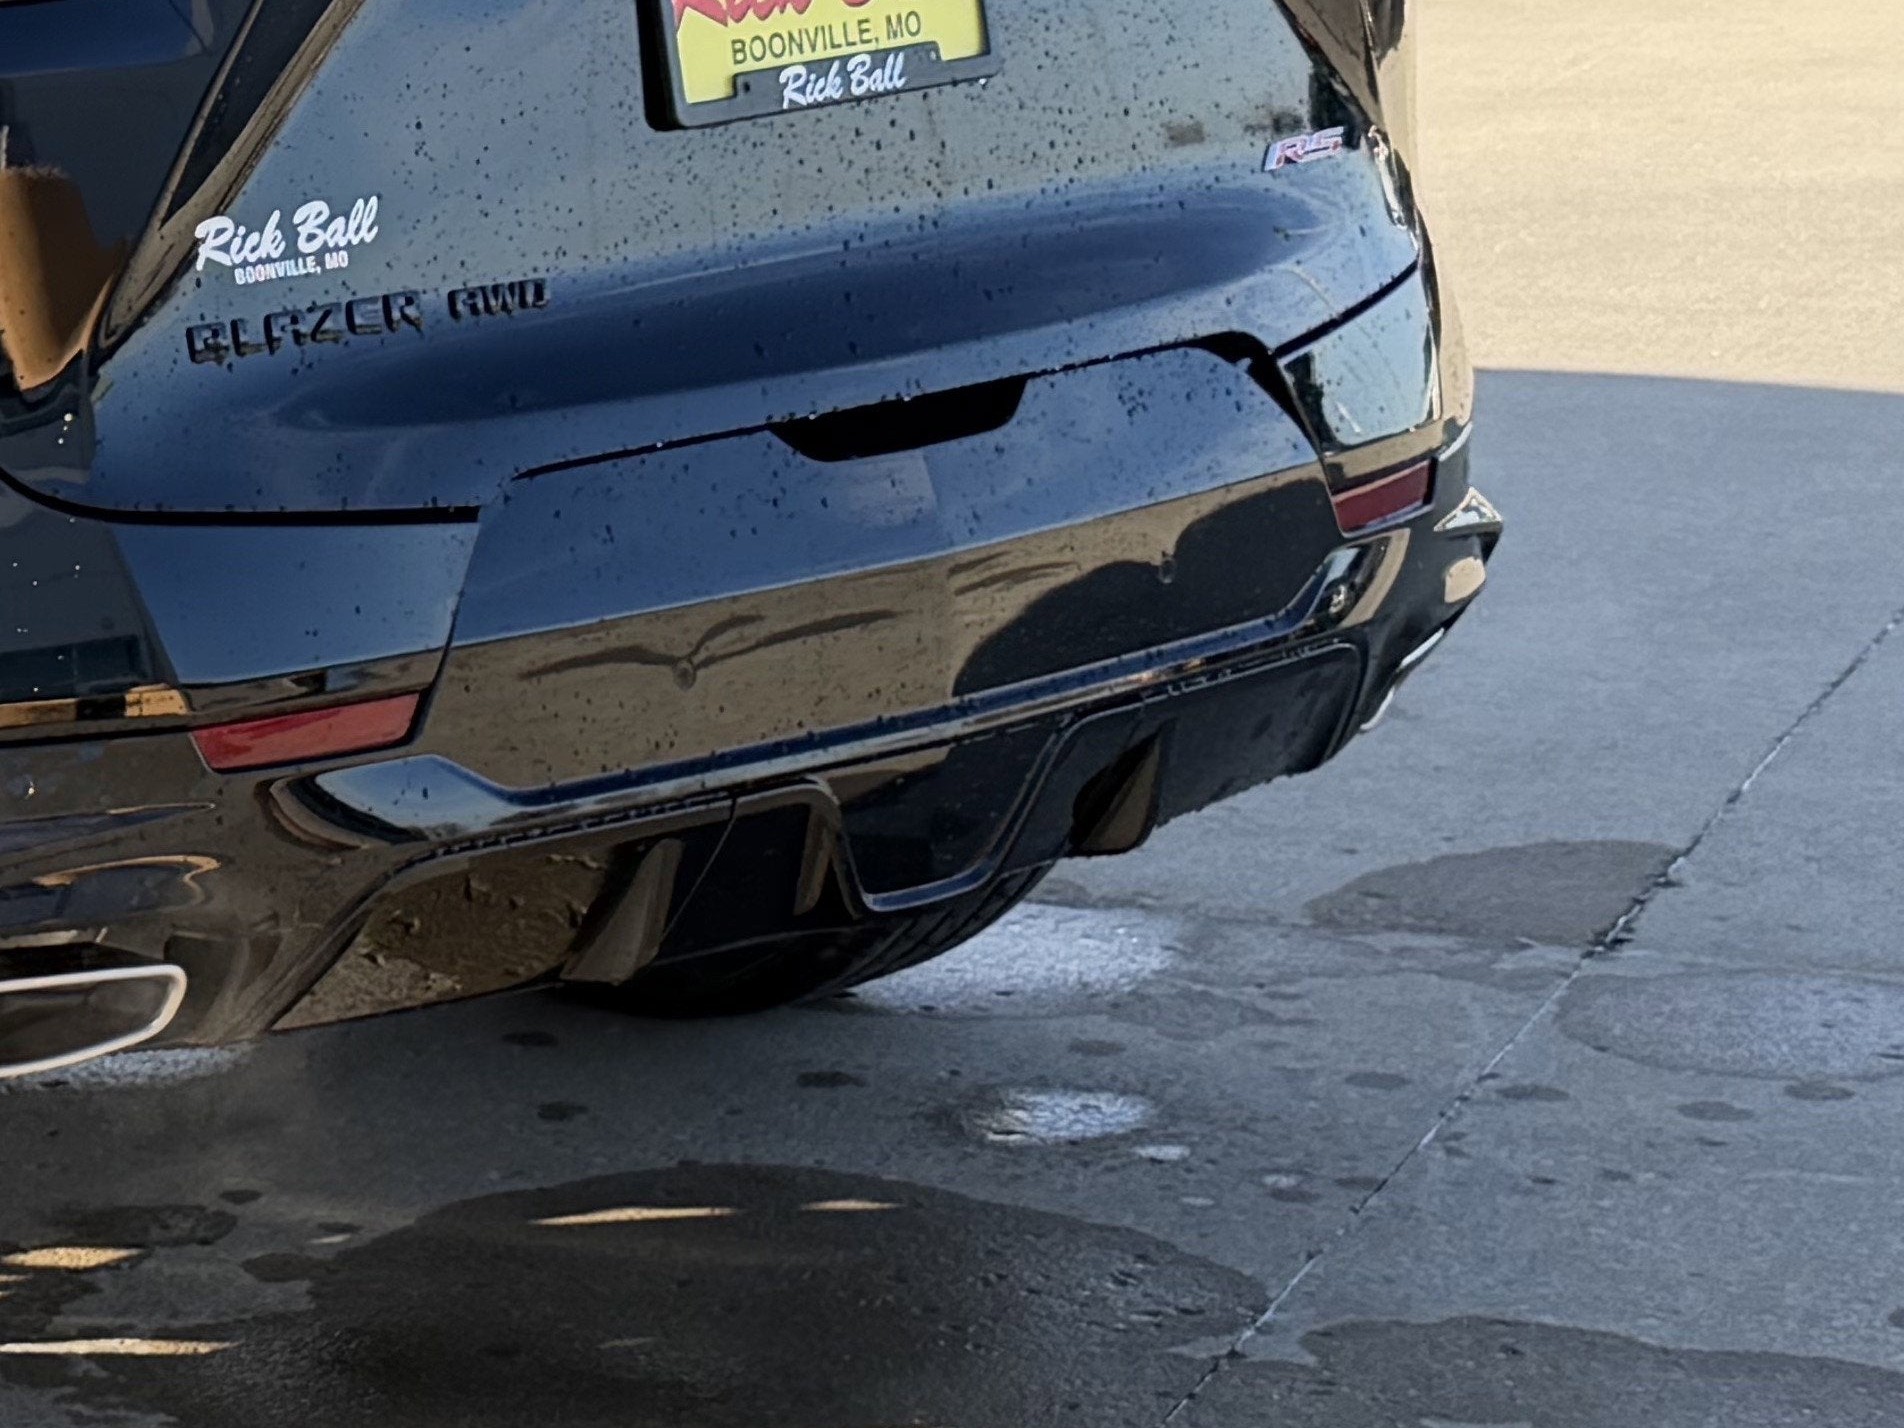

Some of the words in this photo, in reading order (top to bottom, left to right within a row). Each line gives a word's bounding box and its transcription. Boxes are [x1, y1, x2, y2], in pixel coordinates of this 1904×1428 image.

[731, 17, 880, 65] BOONVILLE,
[886, 10, 922, 41] MO
[778, 63, 843, 110] Rick
[846, 52, 907, 93] Ball
[1261, 126, 1344, 172] RS
[195, 210, 286, 271] Rick
[293, 196, 379, 253] Ball
[234, 255, 322, 285] BOONVILLE,
[325, 250, 349, 270] MO
[186, 290, 423, 365] BLAZER
[448, 278, 552, 320] AWD
